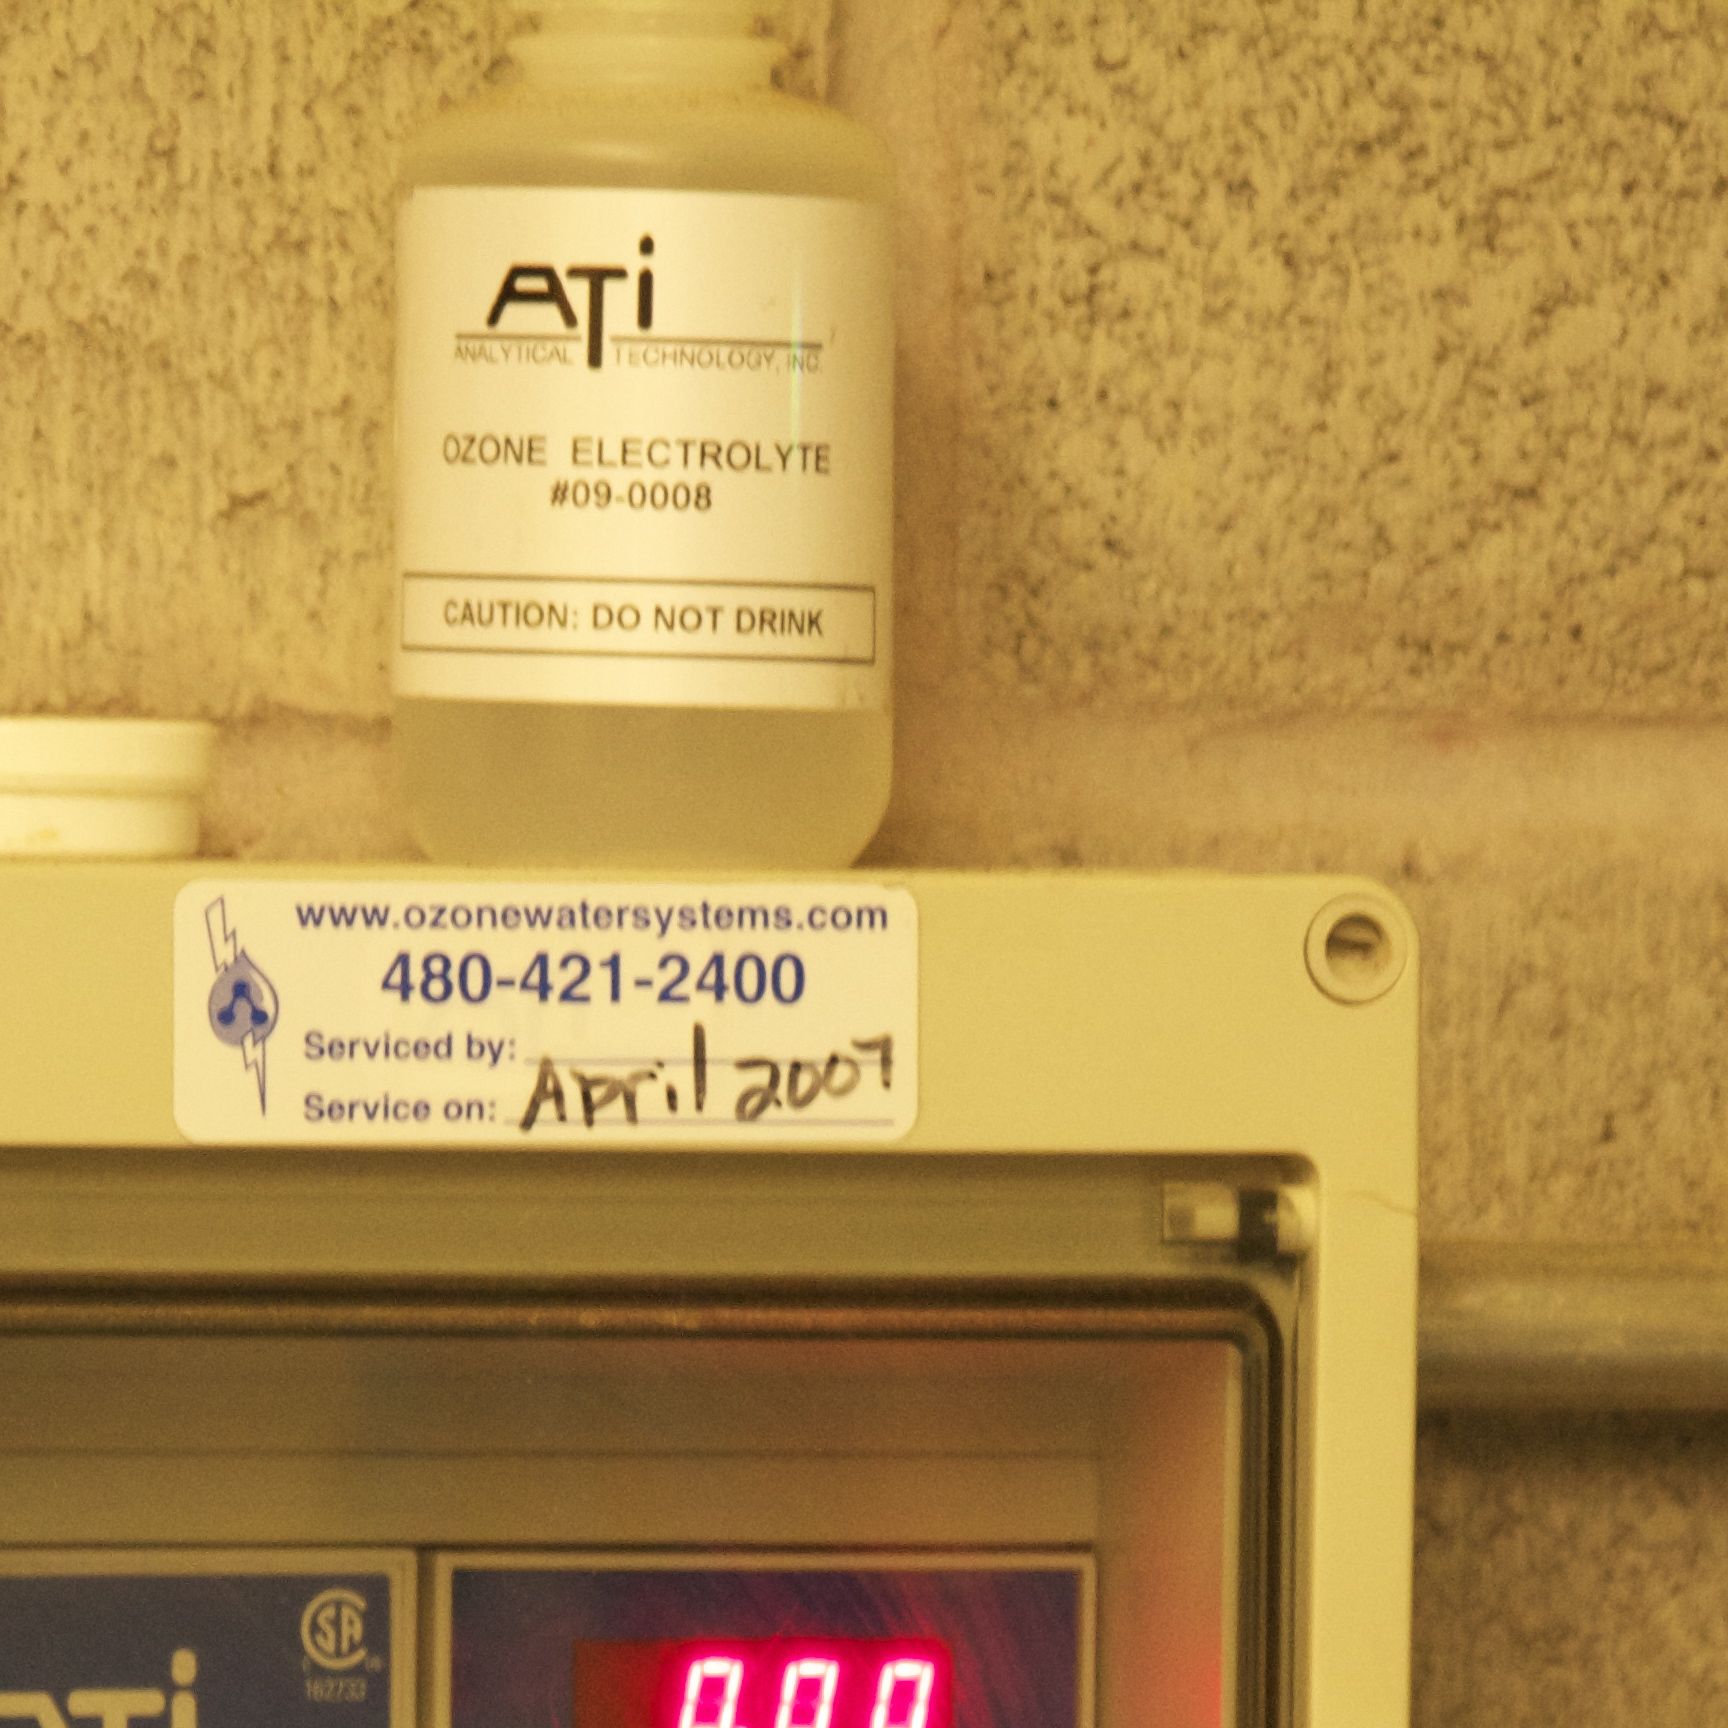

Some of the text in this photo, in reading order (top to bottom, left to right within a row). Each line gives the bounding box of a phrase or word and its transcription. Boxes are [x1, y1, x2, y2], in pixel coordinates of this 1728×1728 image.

[454, 340, 574, 364] ANALYTICAL
[442, 433, 831, 475] OZONE ELECTROLYTE
[550, 480, 713, 512] #09-0008
[443, 600, 824, 638] CAUTION: DO NOT DRINK
[295, 899, 889, 937] www.ozonewatersystems.com
[381, 951, 806, 1004] 480-421-2400
[304, 1030, 516, 1068] Serviced by:
[519, 1022, 893, 1132] April 2007
[304, 1092, 497, 1122] Service on:
